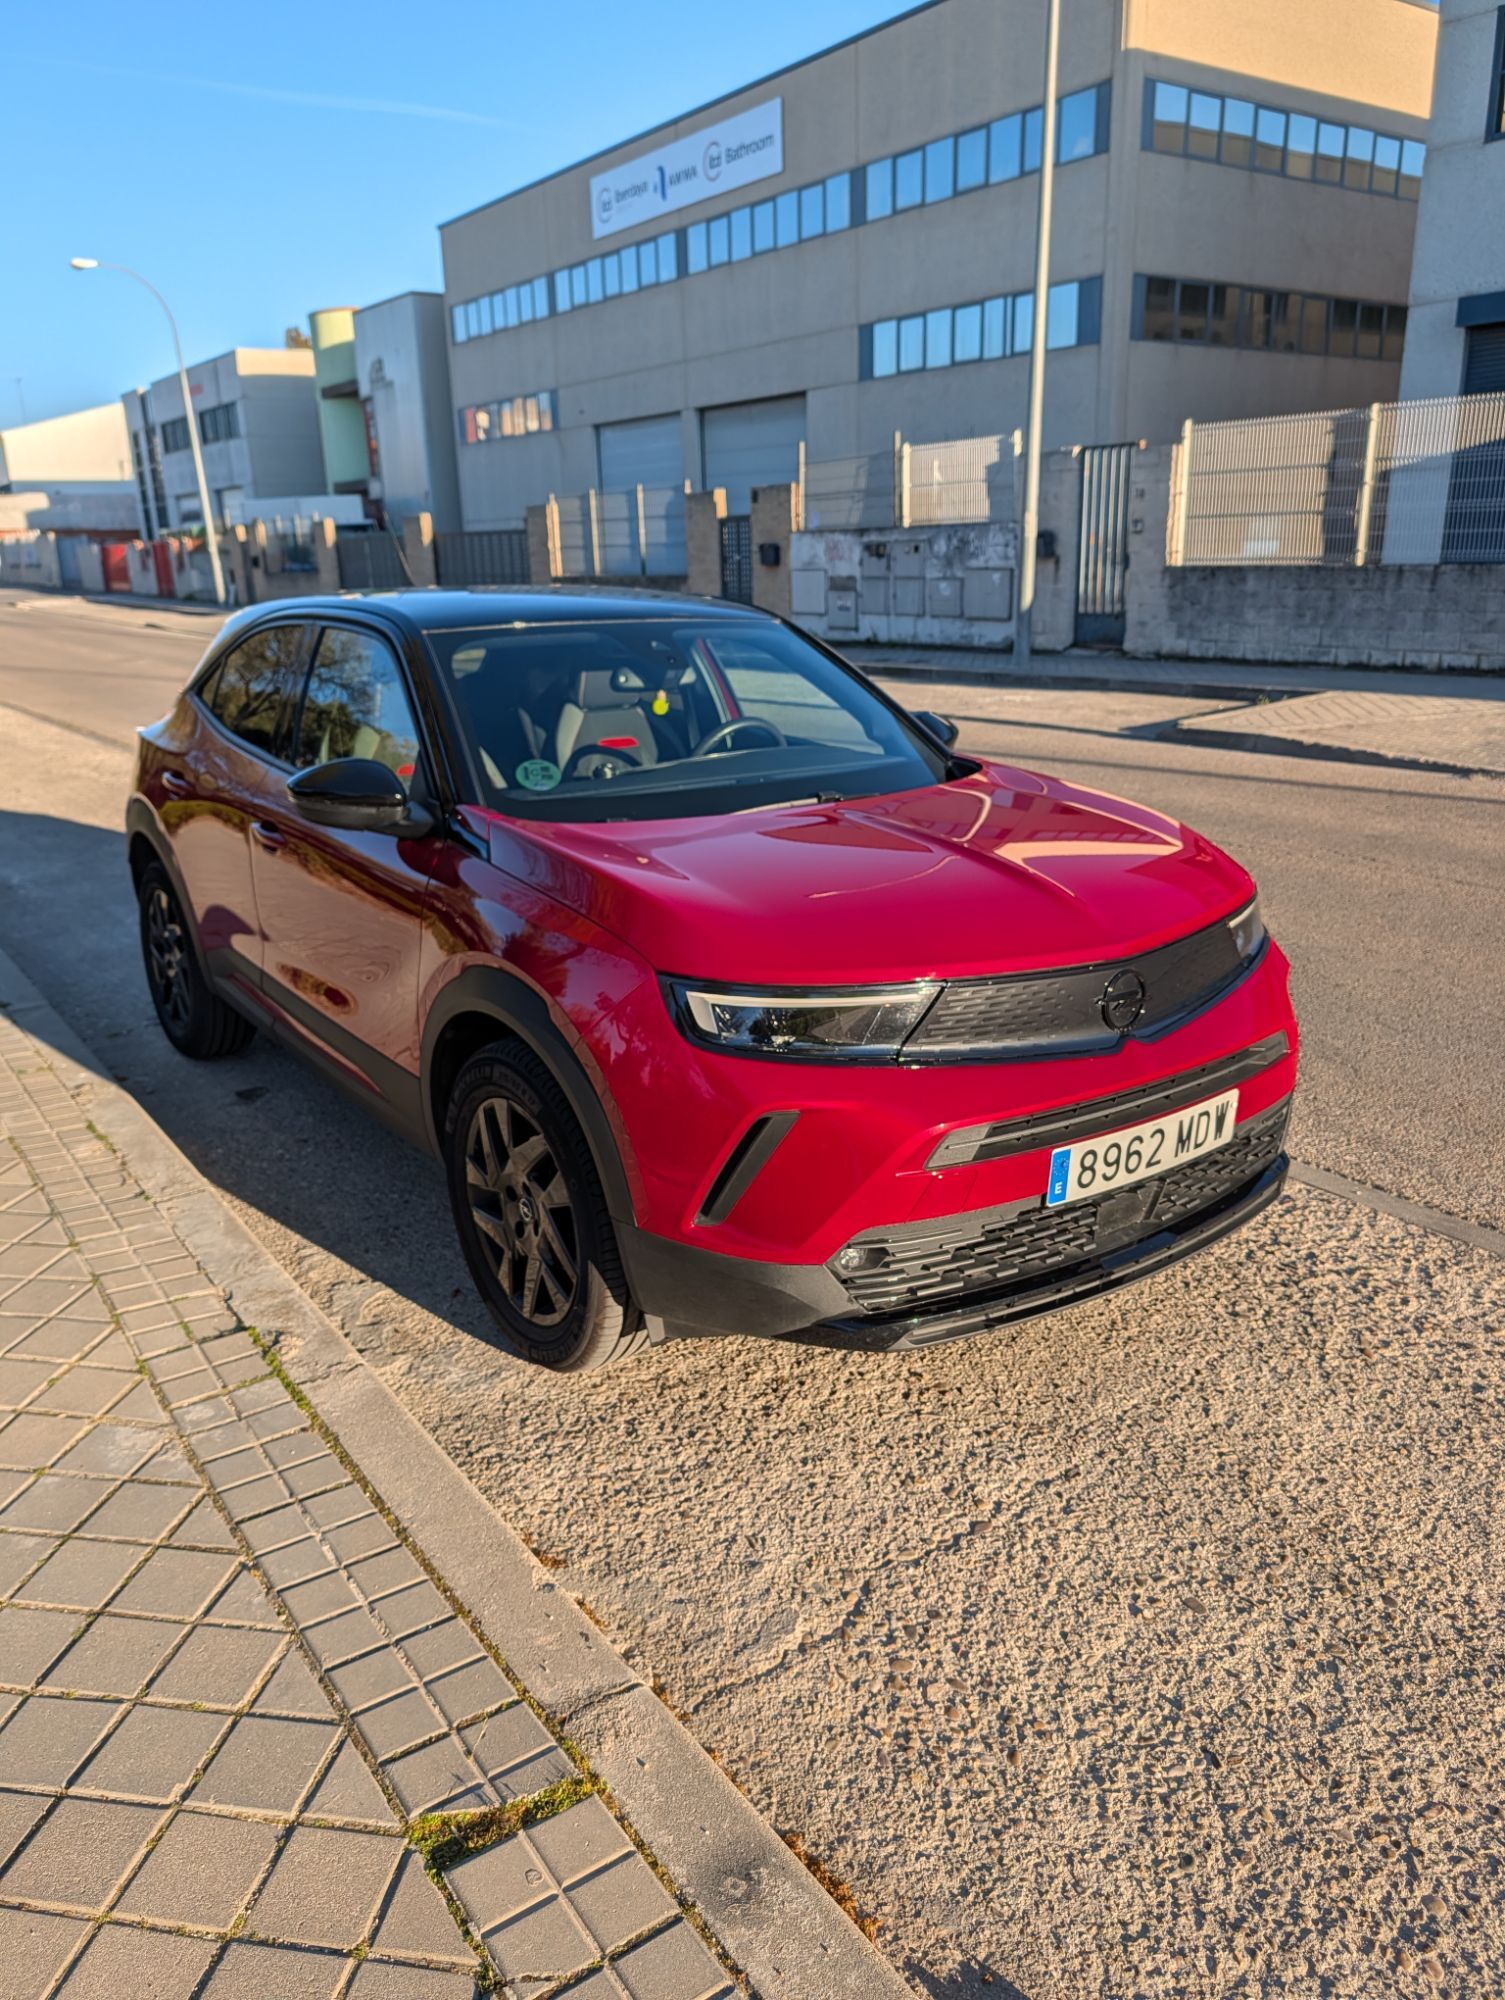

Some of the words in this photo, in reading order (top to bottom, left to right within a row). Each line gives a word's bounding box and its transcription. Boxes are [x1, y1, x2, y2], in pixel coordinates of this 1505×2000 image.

[725, 132, 775, 165] Bathroom
[1077, 1127, 1165, 1189] 8962
[1174, 1099, 1230, 1158] MDW
[1054, 1181, 1063, 1194] E
